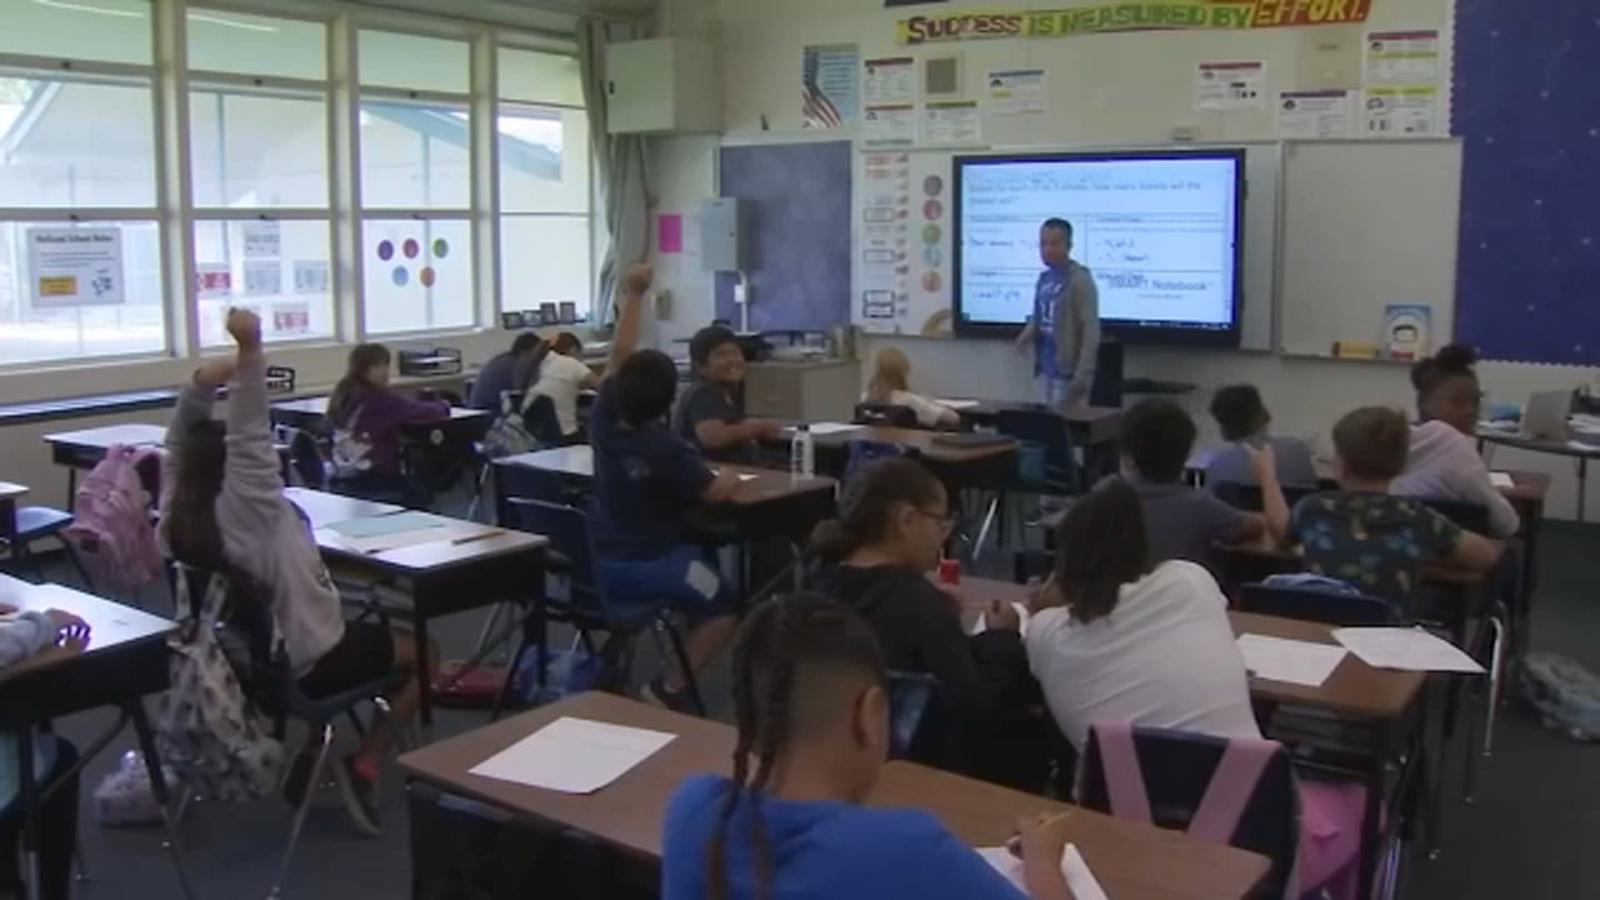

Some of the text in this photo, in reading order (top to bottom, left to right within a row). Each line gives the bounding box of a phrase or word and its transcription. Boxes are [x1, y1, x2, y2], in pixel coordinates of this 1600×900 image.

[907, 15, 1021, 42] SUCCESS
[1028, 15, 1054, 35] IS
[1058, 4, 1206, 33] MEASURED
[1210, 6, 1250, 27] BY
[1152, 280, 1208, 291] Notebook
